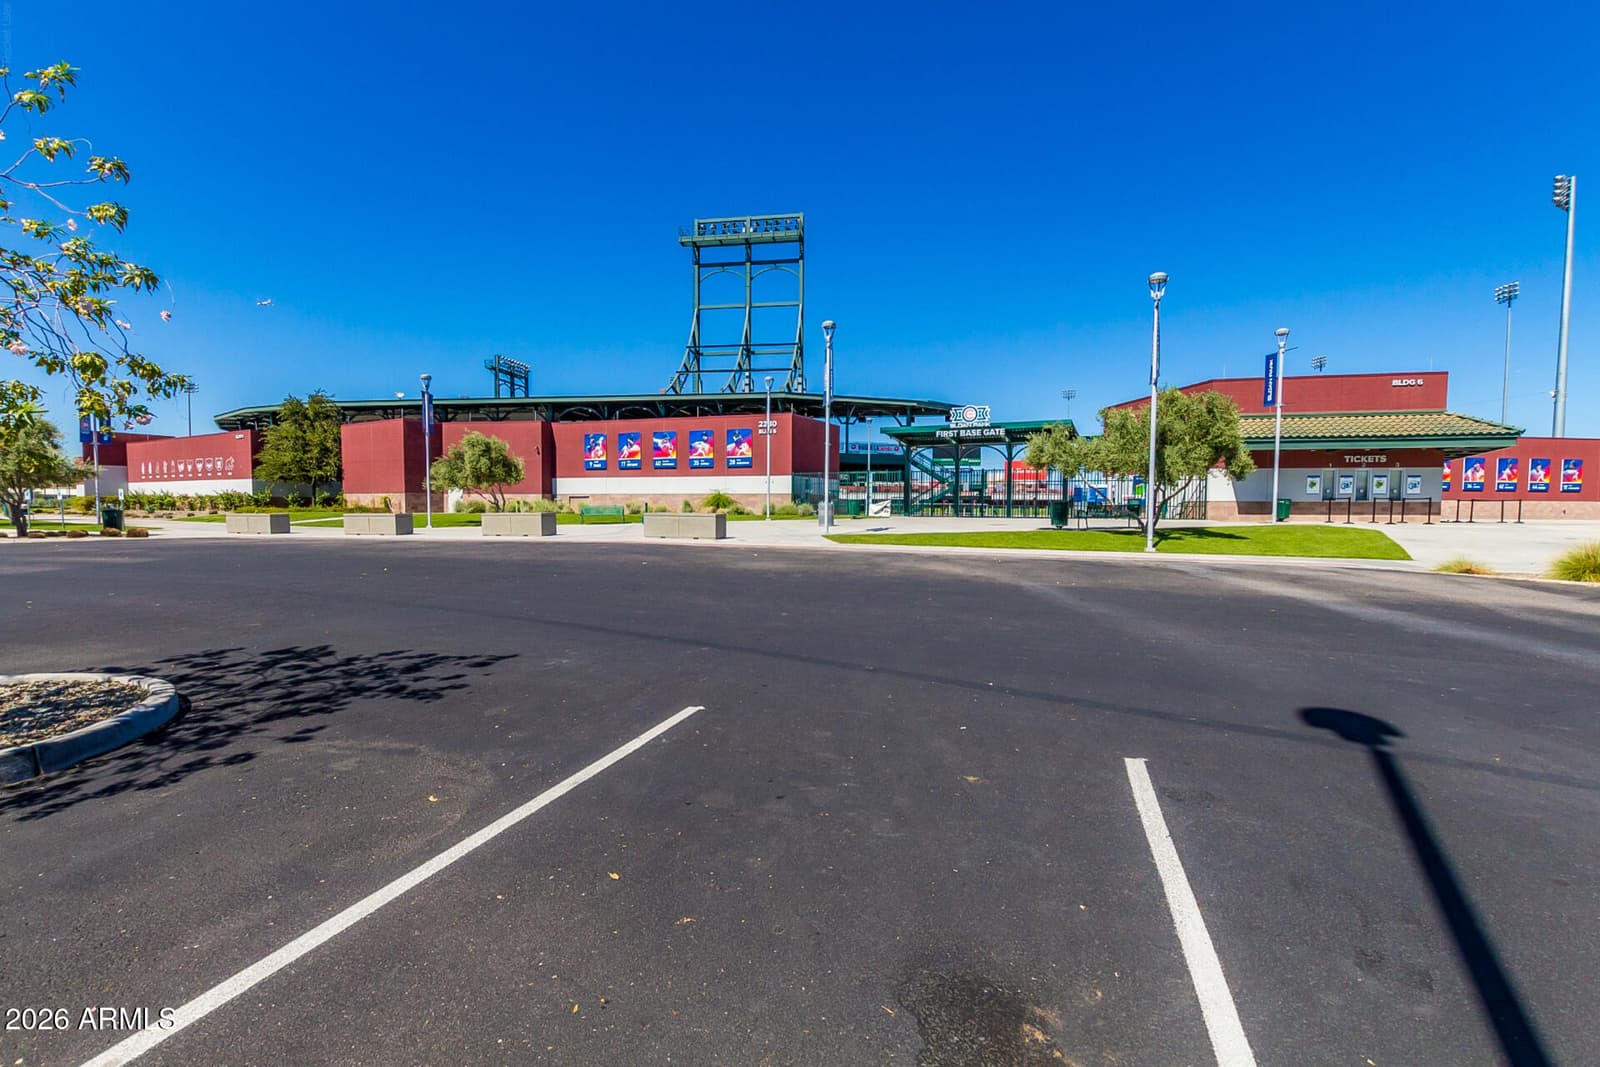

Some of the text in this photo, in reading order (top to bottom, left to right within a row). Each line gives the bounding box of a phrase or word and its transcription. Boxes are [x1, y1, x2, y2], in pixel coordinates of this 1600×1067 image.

[936, 428, 1005, 438] FIRST BASE GATE
[1344, 455, 1387, 463] TICKETS
